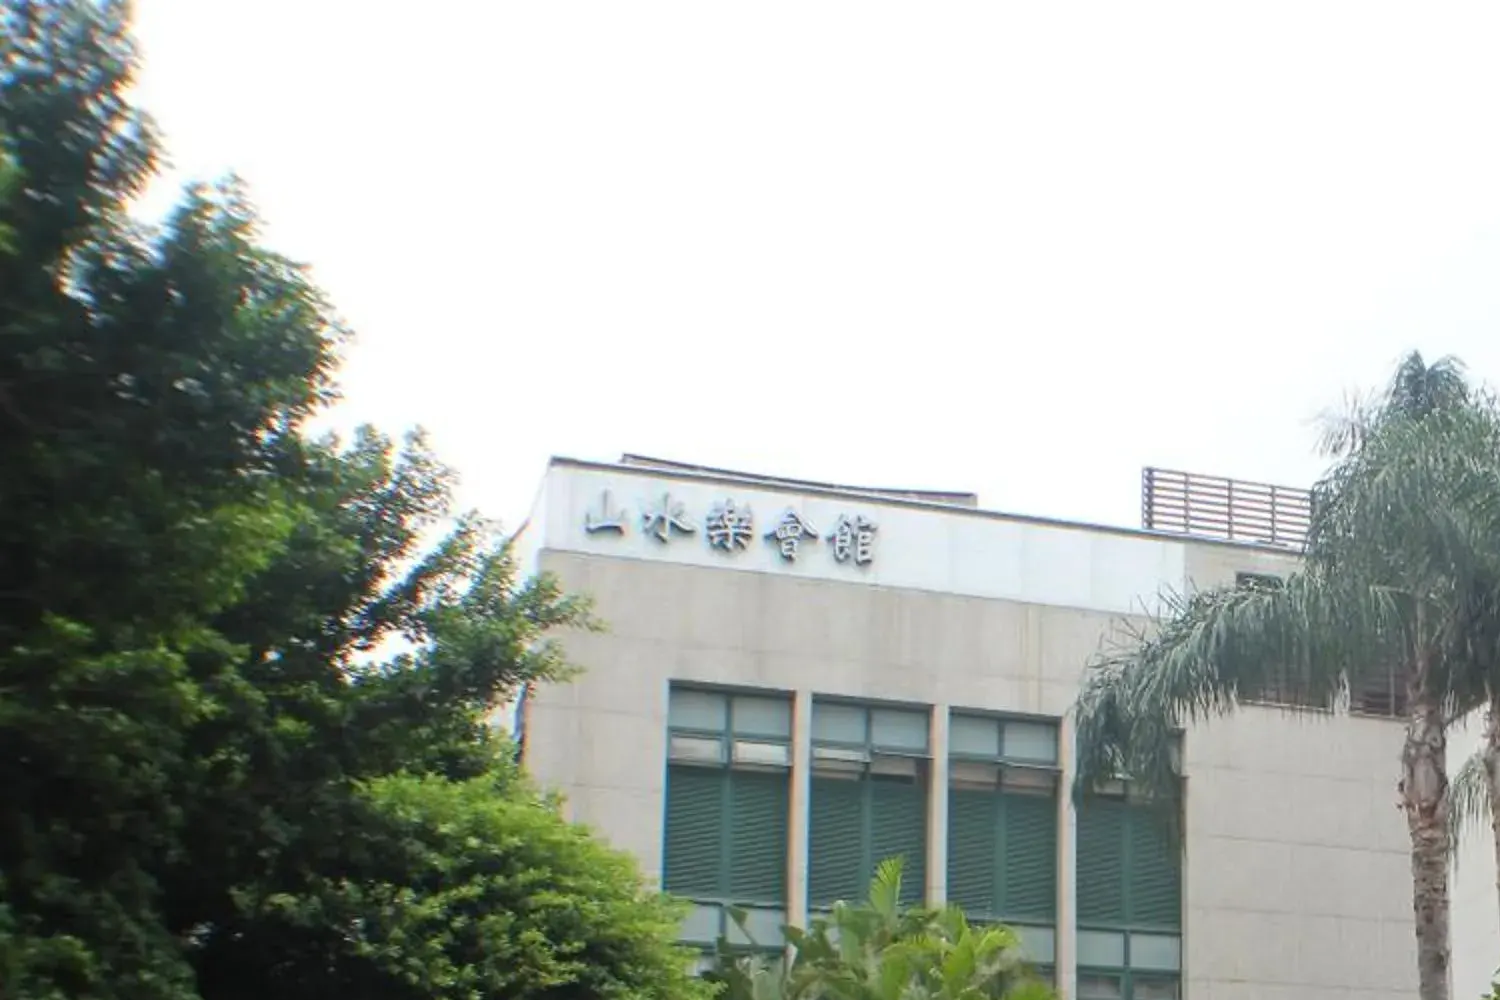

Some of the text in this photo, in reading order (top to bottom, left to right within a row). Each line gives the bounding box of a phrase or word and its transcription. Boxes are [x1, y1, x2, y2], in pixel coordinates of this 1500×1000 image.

[584, 487, 878, 565] 山水樂會館
